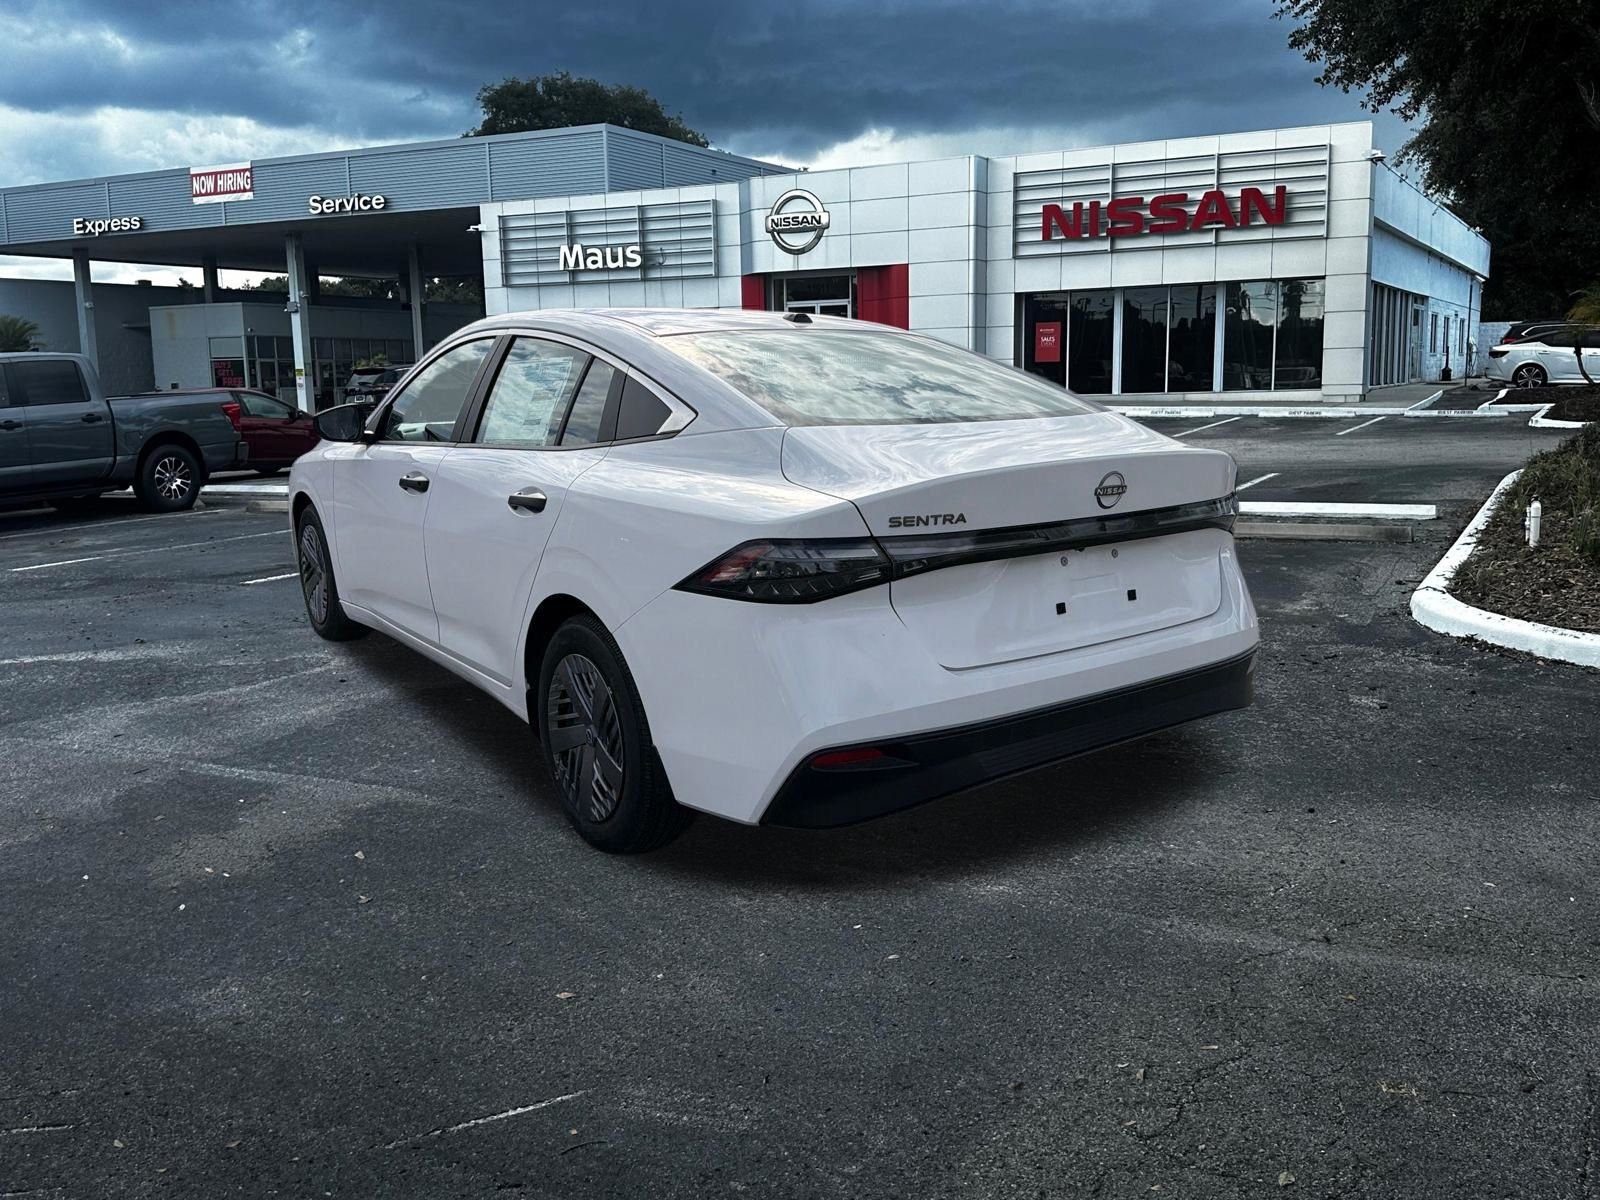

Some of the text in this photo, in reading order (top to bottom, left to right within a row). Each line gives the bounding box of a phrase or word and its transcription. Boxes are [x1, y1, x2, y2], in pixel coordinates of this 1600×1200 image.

[192, 171, 251, 195] NOW HIRING
[308, 193, 386, 215] Service
[1042, 185, 1287, 240] NISSAN
[72, 216, 141, 237] Express
[770, 214, 822, 230] NISSAN
[559, 244, 642, 270] Maus
[1095, 486, 1127, 497] NISSAN
[888, 512, 967, 528] SENTRA
